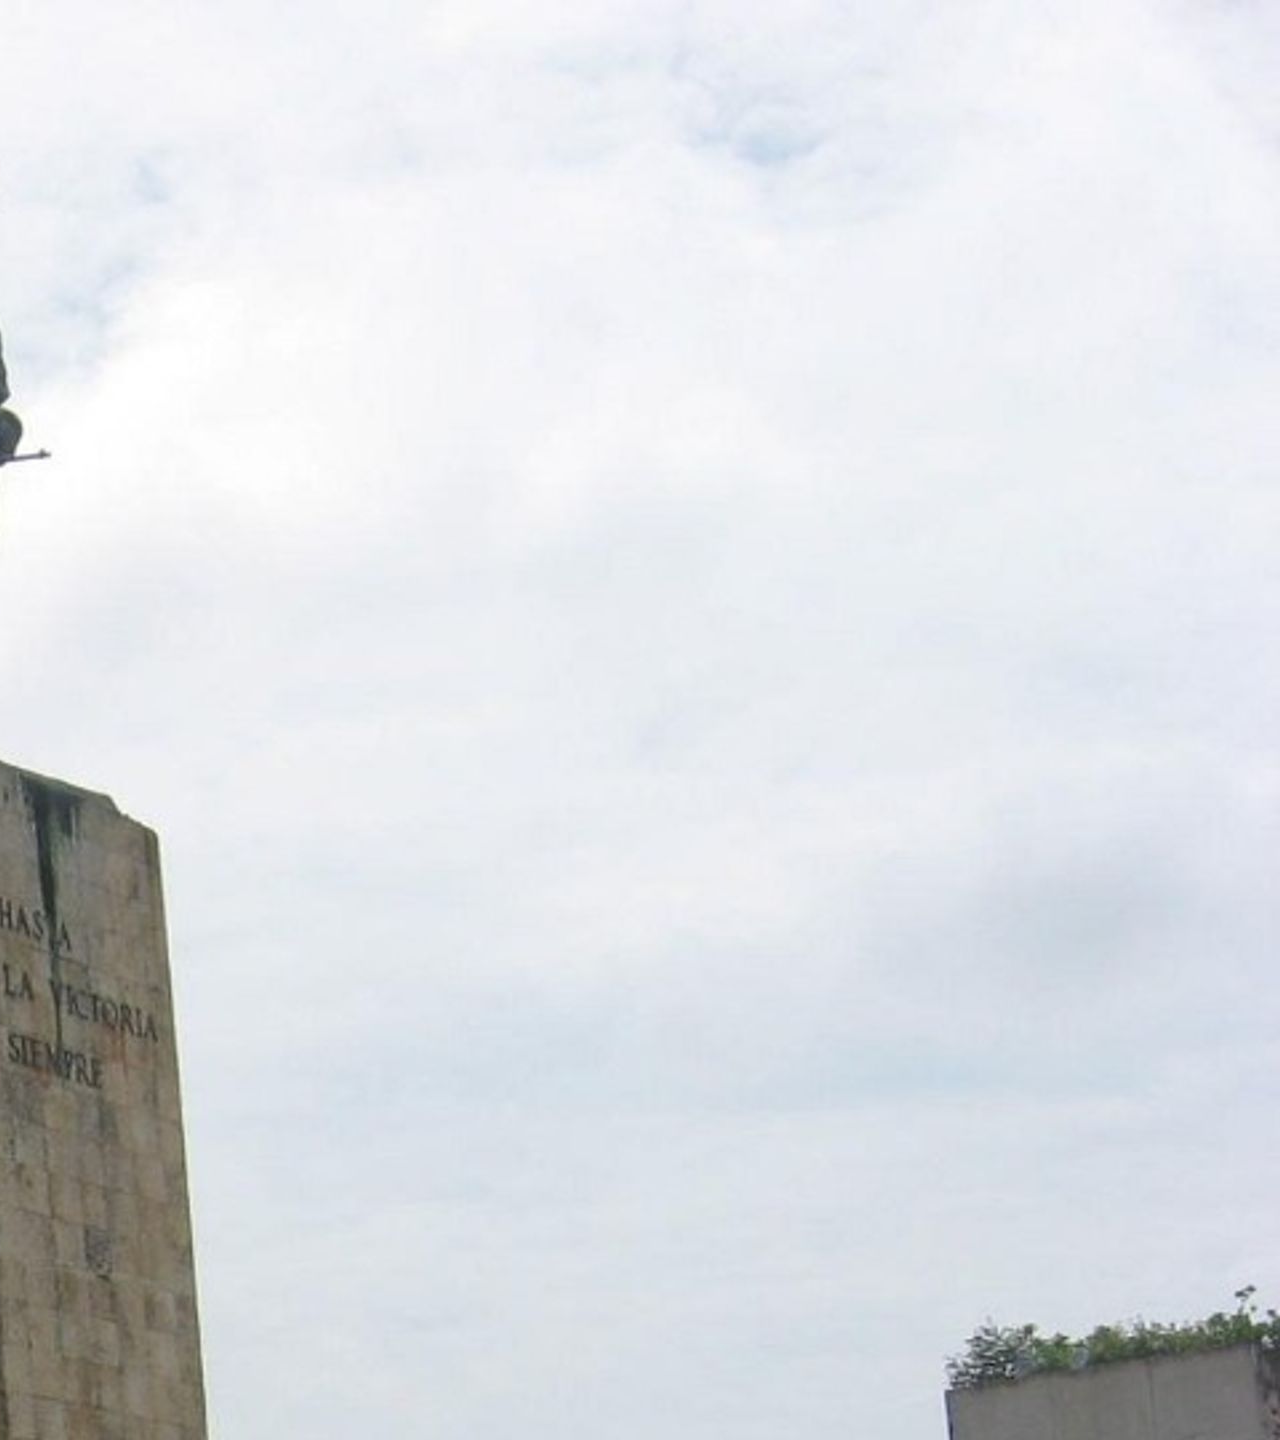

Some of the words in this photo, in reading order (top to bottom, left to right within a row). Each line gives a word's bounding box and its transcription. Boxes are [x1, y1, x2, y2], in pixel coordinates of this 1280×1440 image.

[2, 963, 34, 1001] LA
[49, 979, 158, 1043] VICTORIA
[7, 1032, 103, 1088] SIEMPRE
